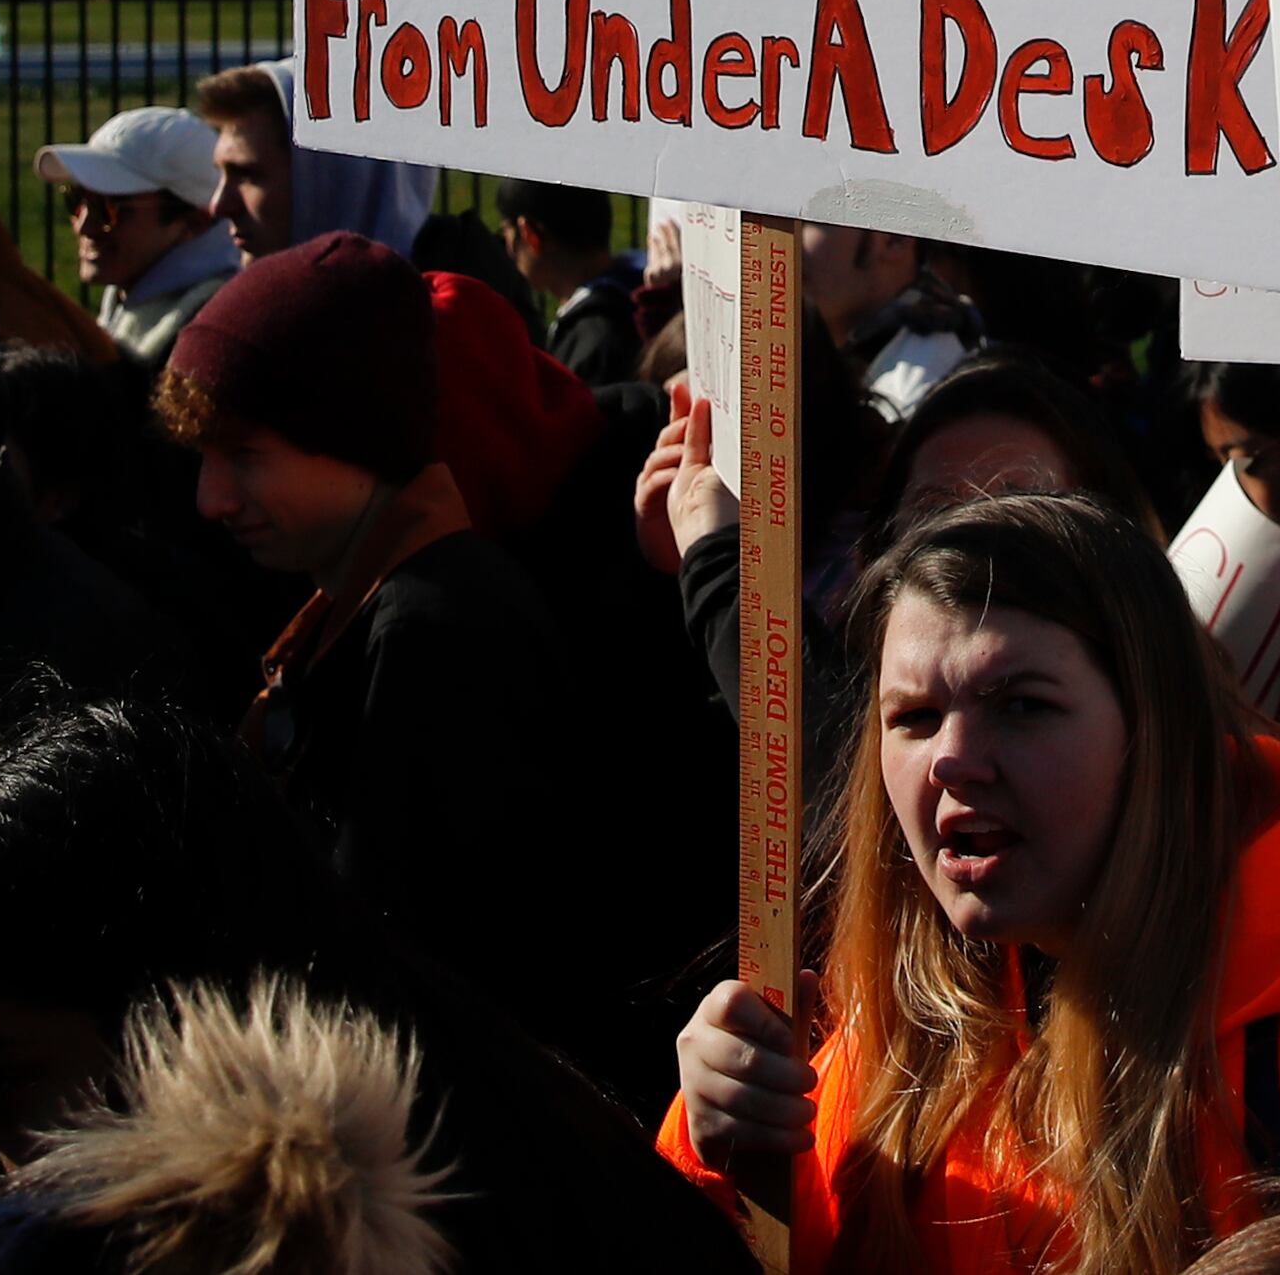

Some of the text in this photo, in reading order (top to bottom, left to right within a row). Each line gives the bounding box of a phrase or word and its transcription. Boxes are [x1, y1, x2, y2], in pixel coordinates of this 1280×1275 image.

[752, 260, 762, 283] 22
[752, 307, 762, 330] 21
[752, 355, 762, 379] 20
[770, 242, 787, 527] HOME OF THE FINEST
[752, 402, 762, 423] 19
[752, 451, 762, 471] 18
[752, 498, 762, 518] 17
[751, 545, 761, 565] 16
[751, 592, 761, 612] 15
[751, 639, 761, 658] 14
[751, 686, 761, 705] 13
[751, 731, 761, 751] 12
[766, 609, 788, 902] THE HOME DEPOT
[751, 780, 761, 798] 11
[751, 825, 761, 843] 10
[751, 870, 761, 884] 9
